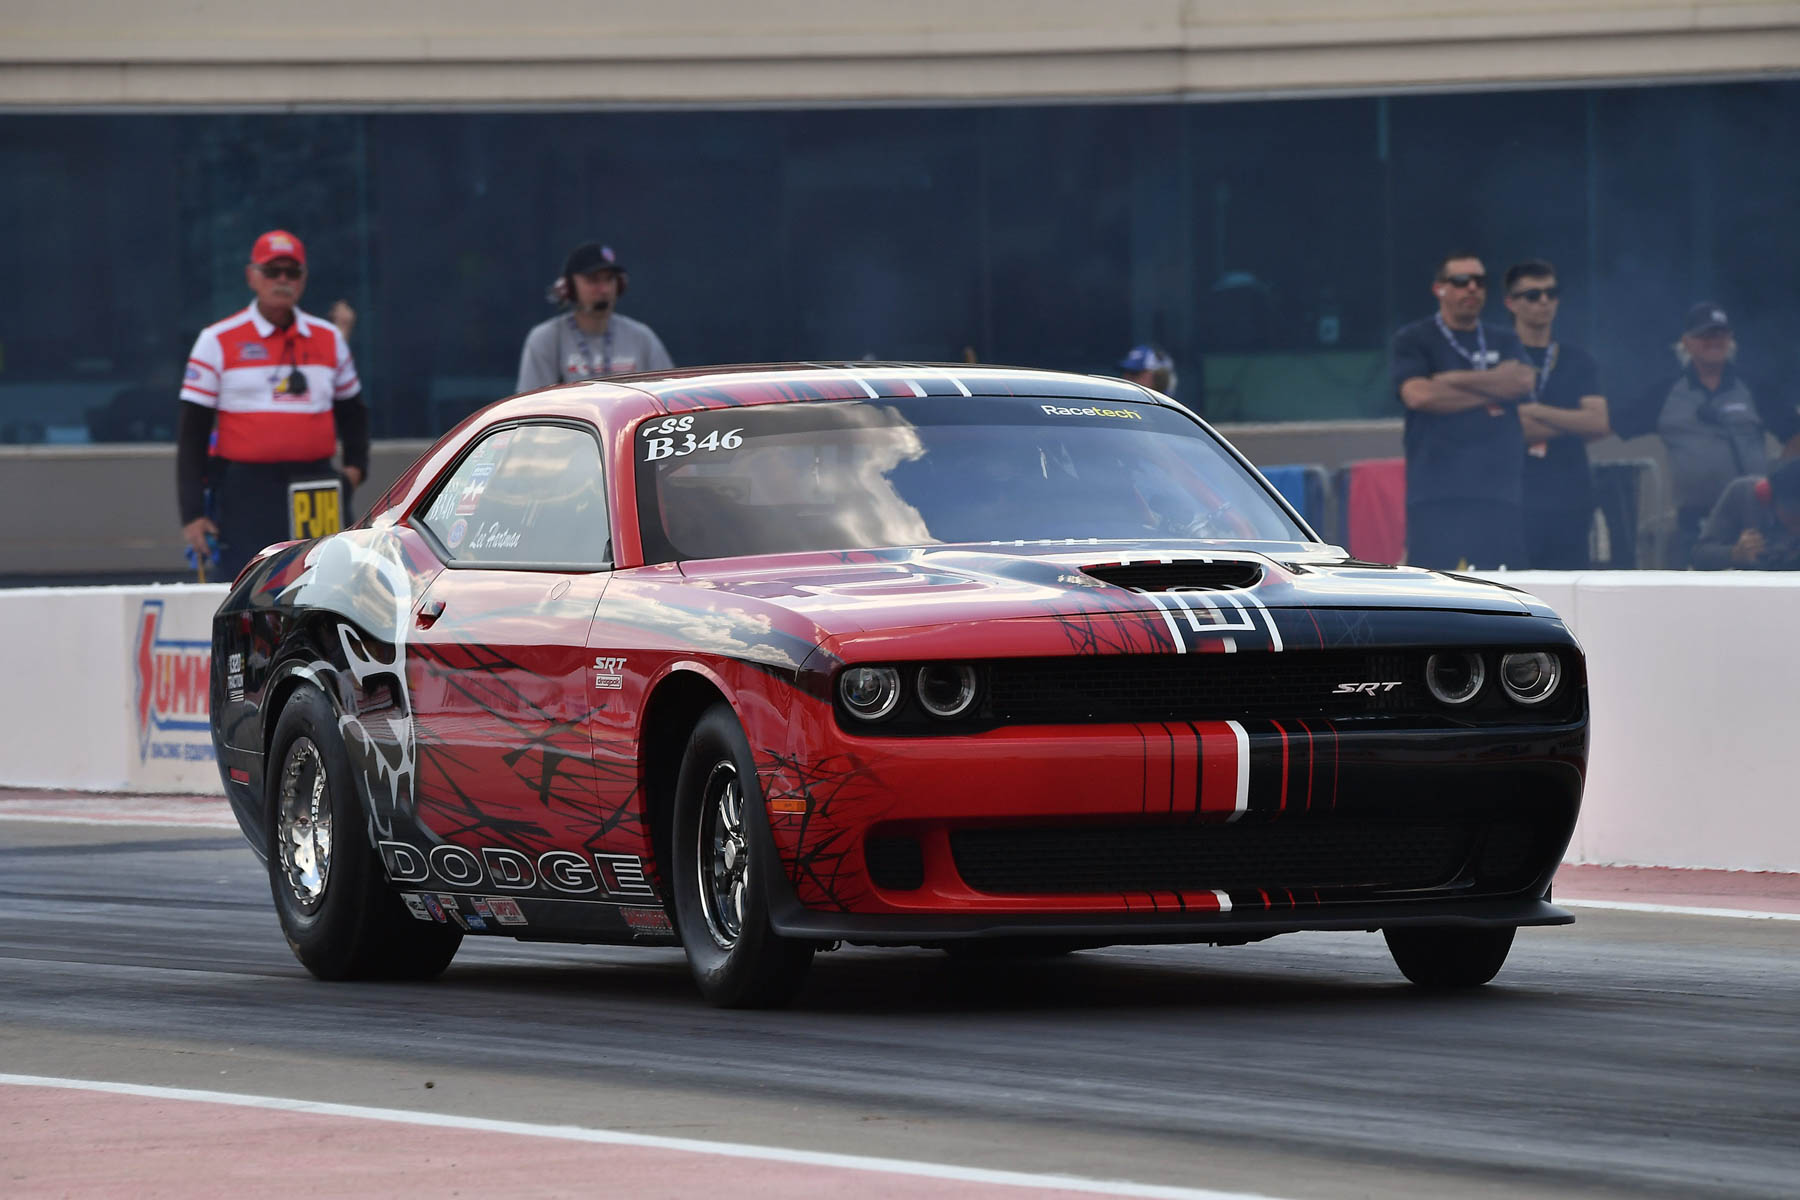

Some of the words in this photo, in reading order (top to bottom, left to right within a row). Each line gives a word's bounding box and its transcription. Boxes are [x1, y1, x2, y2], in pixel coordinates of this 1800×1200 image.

[1041, 405, 1142, 420] Racetech
[643, 428, 745, 462] B346
[593, 656, 627, 674] SRT
[1332, 681, 1403, 696] SRT
[378, 840, 655, 897] DODGE
